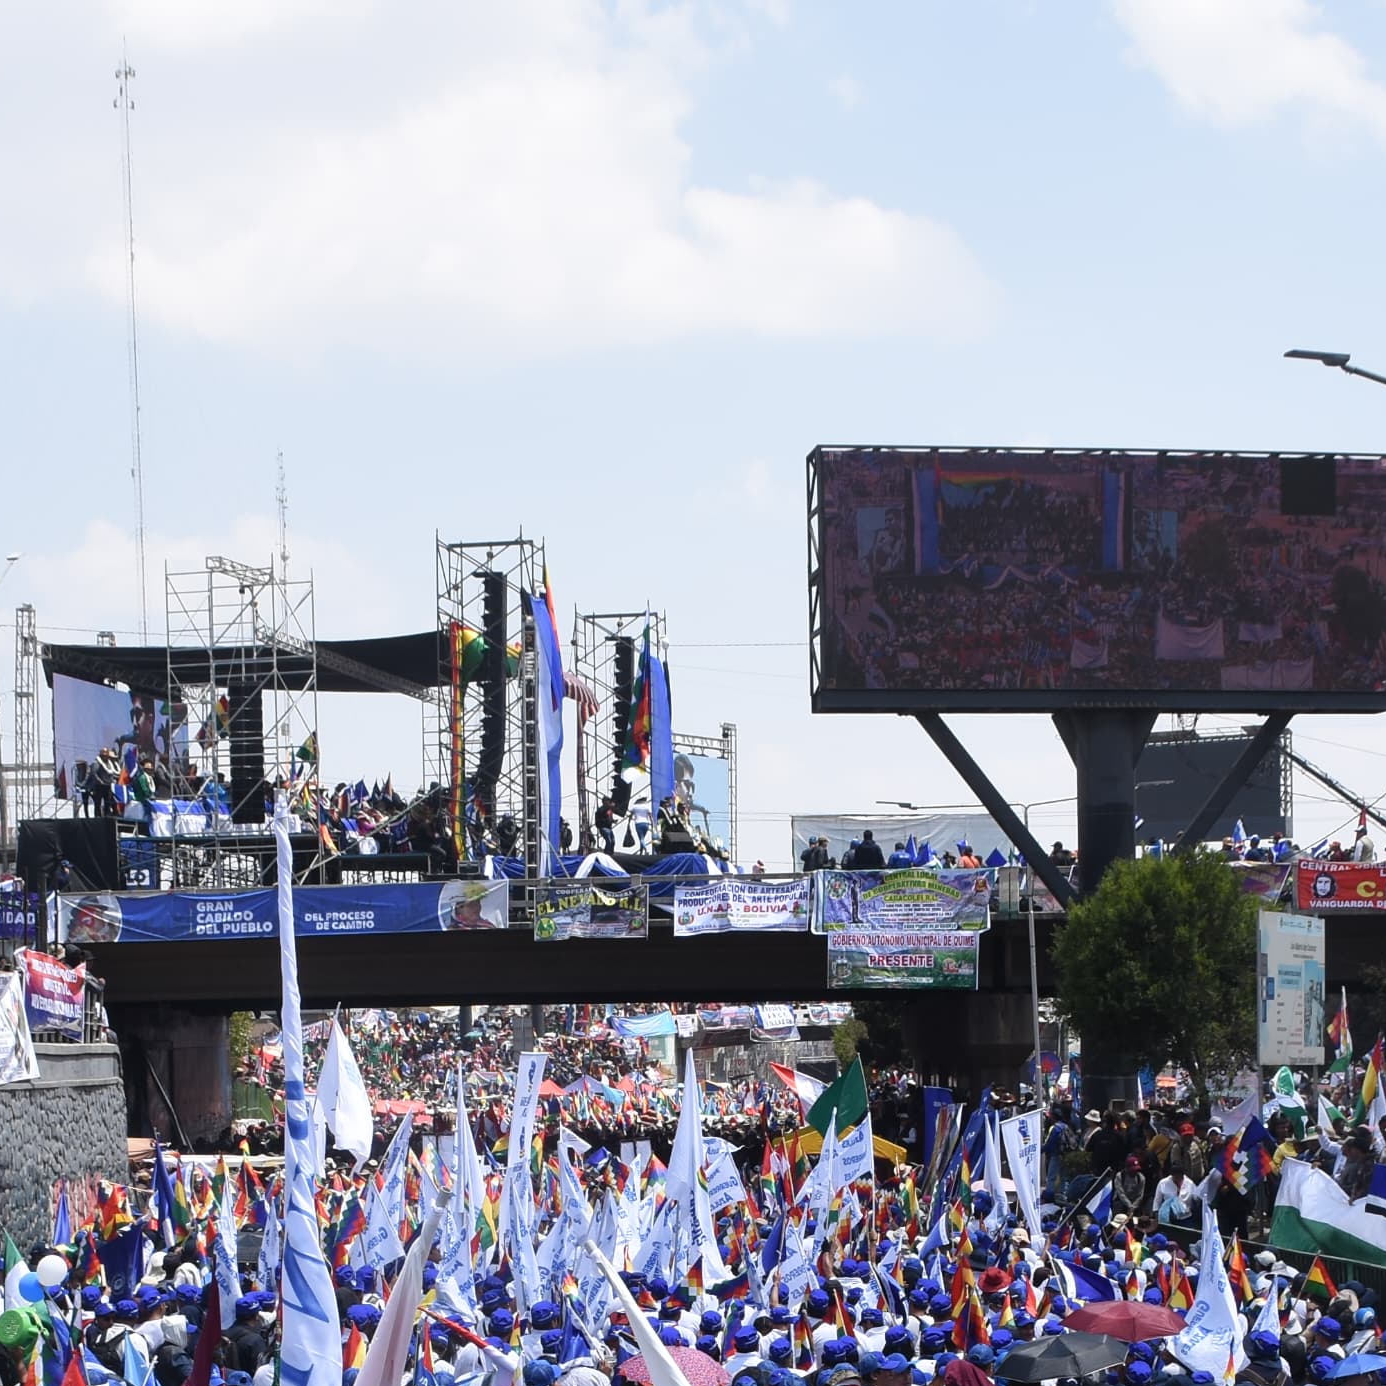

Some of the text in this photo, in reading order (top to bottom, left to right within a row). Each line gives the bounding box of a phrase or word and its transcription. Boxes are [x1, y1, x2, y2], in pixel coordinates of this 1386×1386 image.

[748, 886, 758, 894] DE
[761, 883, 805, 894] ARTESANOS
[733, 894, 747, 902] DEL
[774, 892, 808, 902] POPULAR
[197, 901, 233, 912] GRAN
[537, 901, 555, 916] EL
[743, 904, 788, 913] BOLIVIA
[1309, 899, 1373, 909] VANGUARDIA
[197, 911, 254, 924] CABILDO
[304, 911, 375, 922] DEL PROCESO
[196, 921, 273, 935] DEL PUEBLO
[316, 920, 375, 930] DE CAMBIO
[832, 935, 866, 946] GOBIERNO
[906, 935, 942, 946] MUNICIPAL
[944, 935, 953, 946] DE
[954, 935, 975, 946] QUIME
[869, 955, 934, 968] PRESENTE
